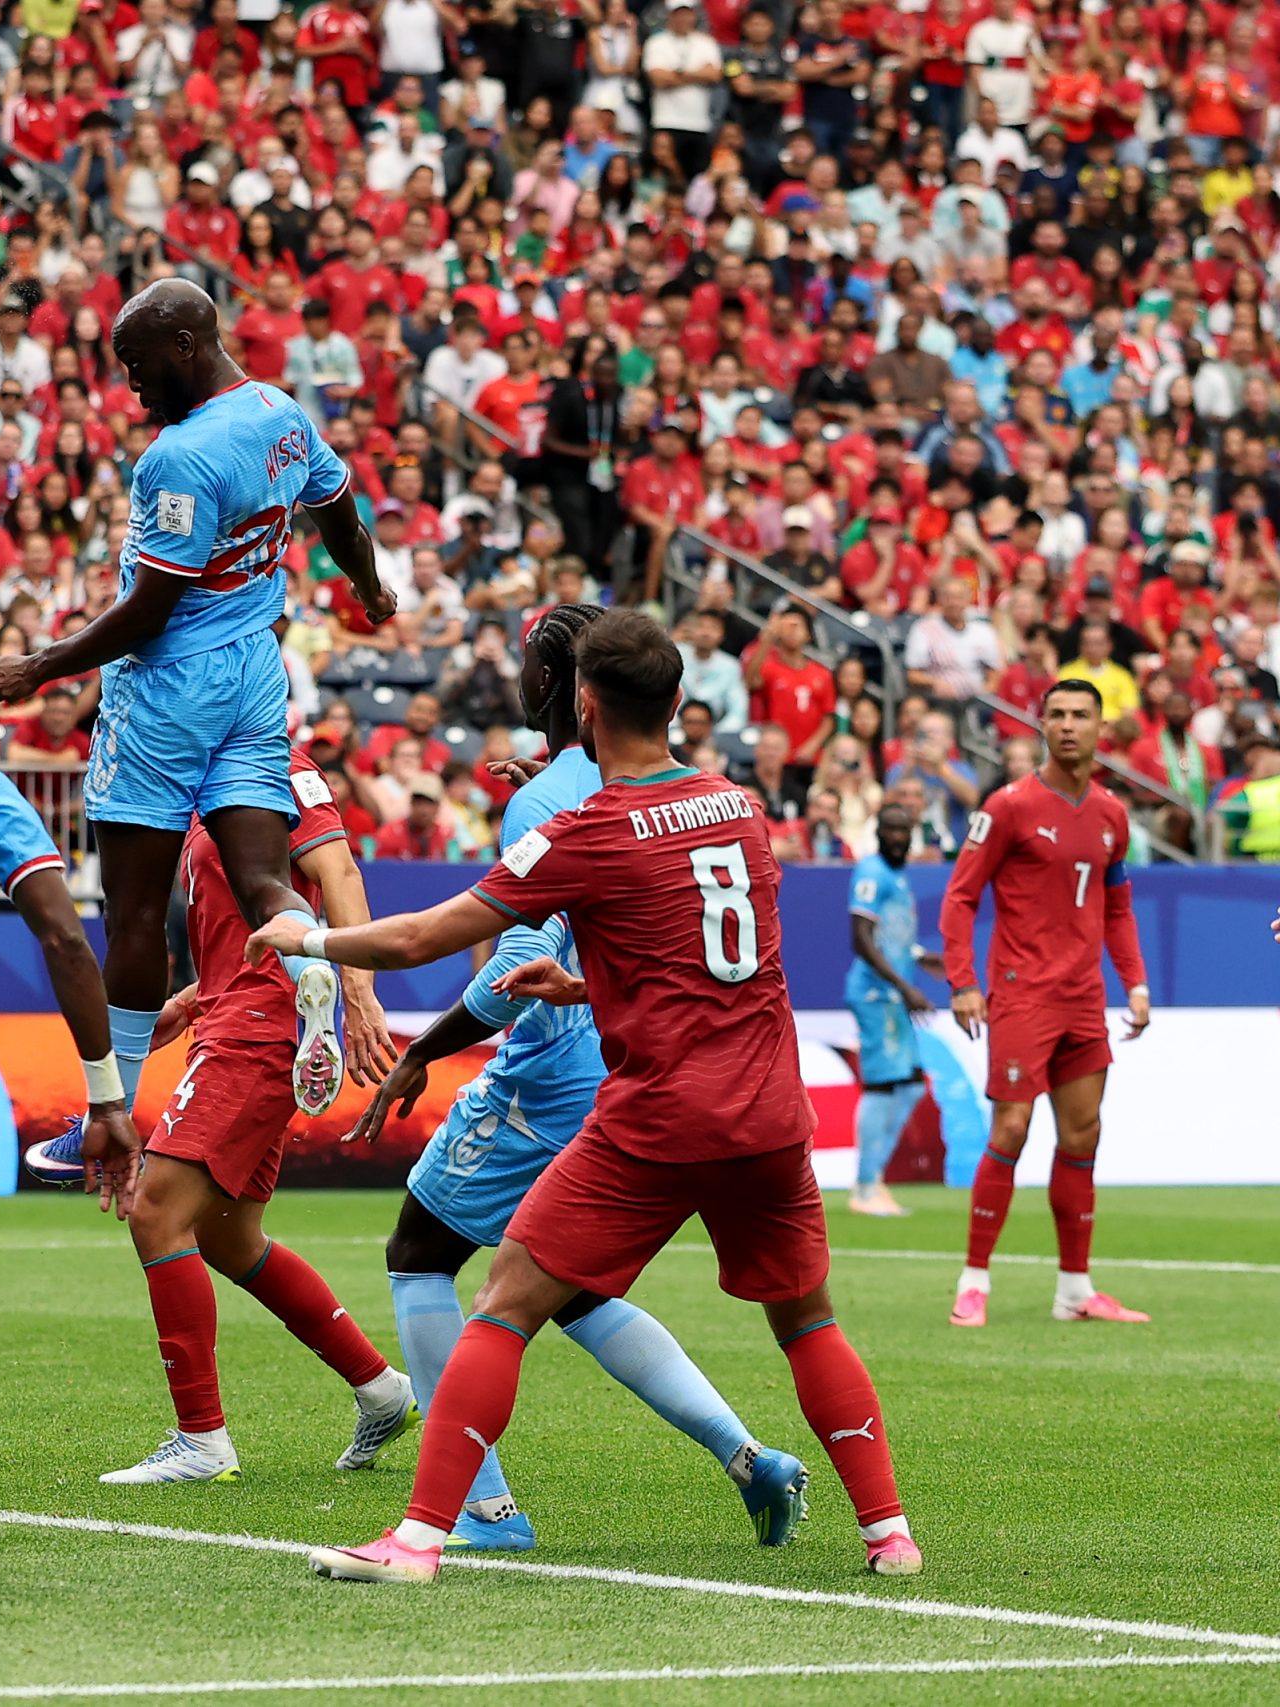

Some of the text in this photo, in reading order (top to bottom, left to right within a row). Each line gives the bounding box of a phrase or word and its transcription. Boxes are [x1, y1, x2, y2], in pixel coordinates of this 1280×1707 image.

[264, 429, 308, 485] WISSA
[628, 789, 754, 841] B.FERNANDES
[687, 839, 760, 983] 8
[1073, 860, 1092, 909] 7
[173, 1054, 207, 1111] 4
